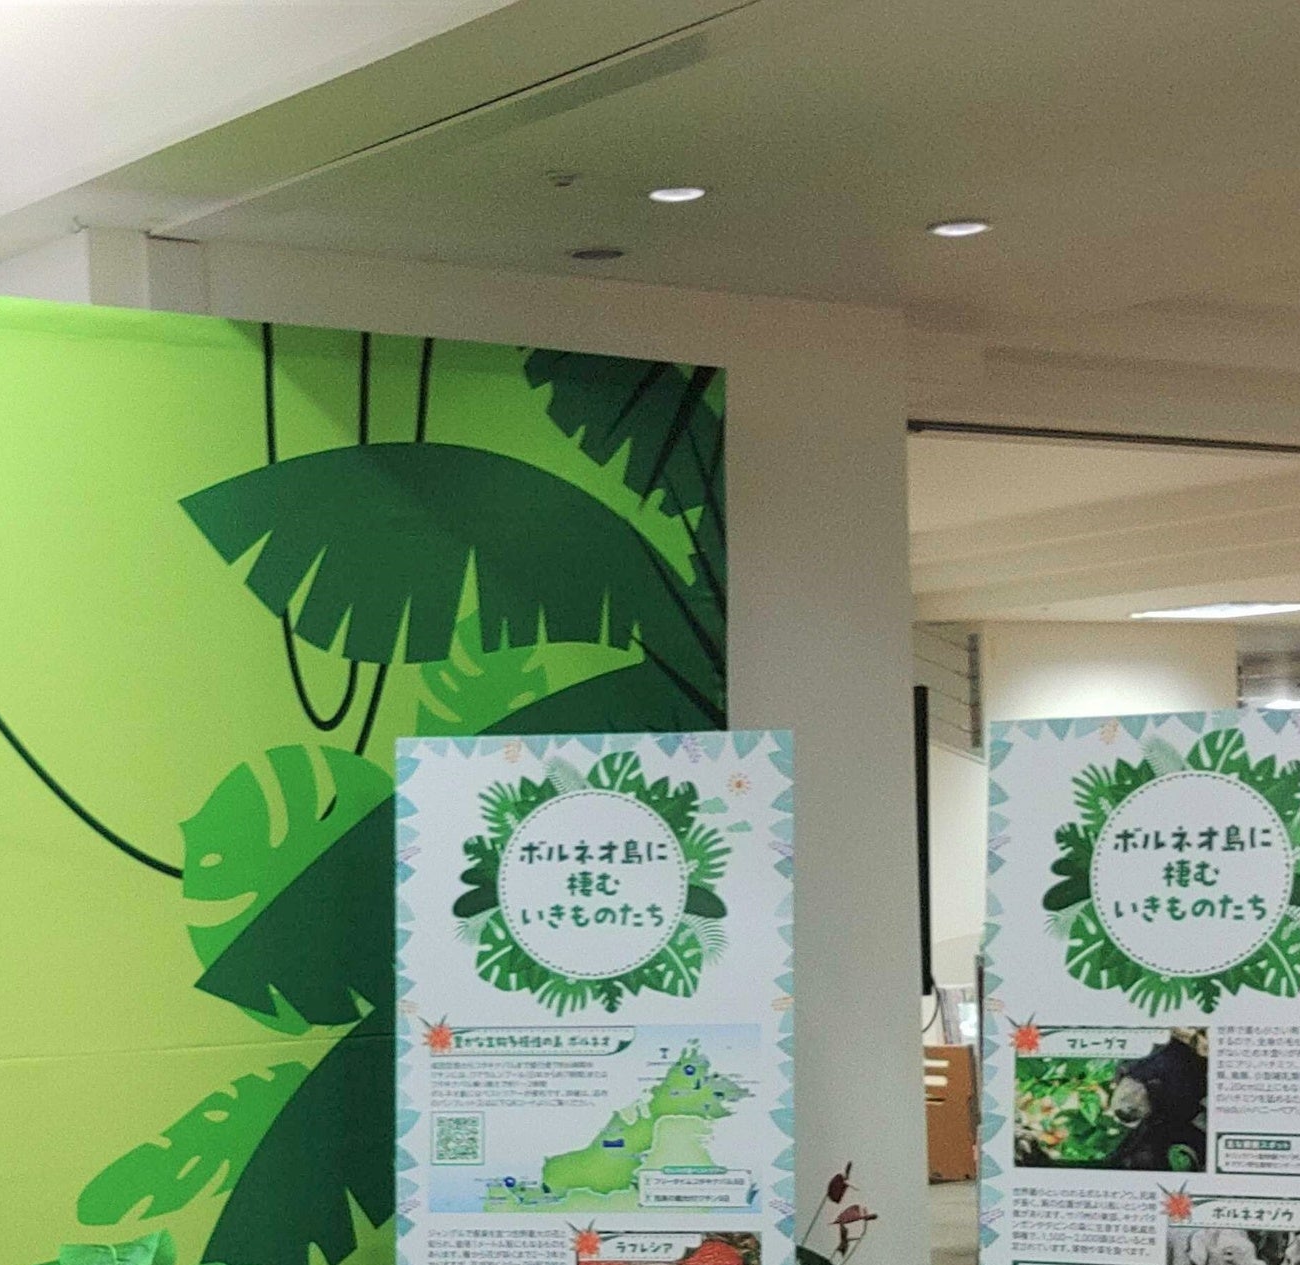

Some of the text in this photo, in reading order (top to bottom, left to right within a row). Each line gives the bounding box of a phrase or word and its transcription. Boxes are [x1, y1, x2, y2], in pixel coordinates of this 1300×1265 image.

[519, 838, 668, 865] ボルネオ島に
[1113, 824, 1272, 853] ボルネオ島に
[566, 870, 620, 897] 棲む
[1162, 859, 1220, 888] 棲む
[520, 903, 665, 929] いきものたち
[1114, 894, 1267, 923] いきものたち
[1066, 1037, 1128, 1051] マレーグマ
[1210, 1205, 1295, 1223] ボルネオゾウ
[615, 1241, 673, 1254] ラフレシア
